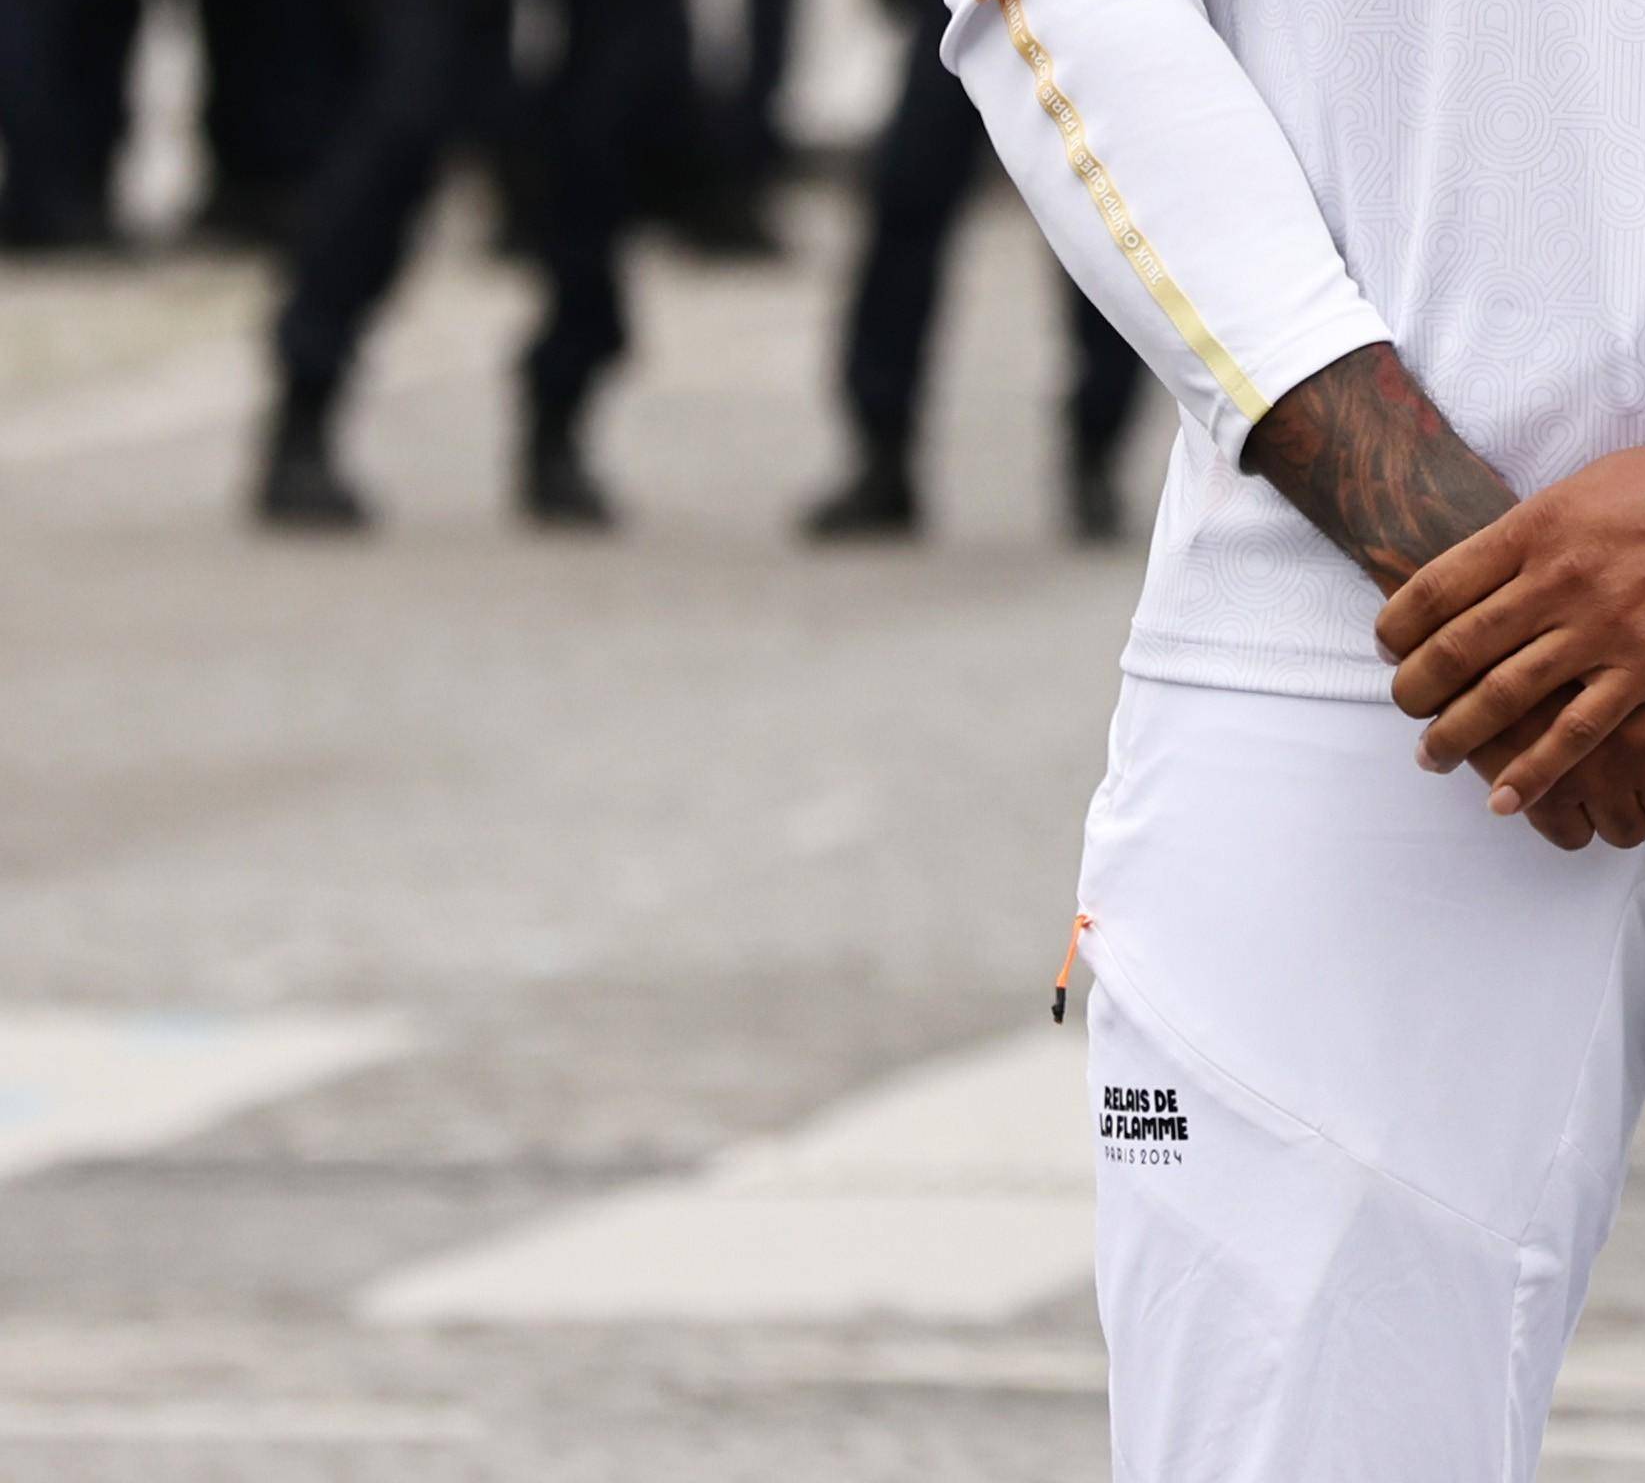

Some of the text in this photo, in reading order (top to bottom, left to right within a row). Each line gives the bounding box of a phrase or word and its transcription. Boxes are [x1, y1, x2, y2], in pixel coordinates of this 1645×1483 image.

[1041, 86, 1079, 134] PARIS
[1136, 247, 1164, 285] JEUX
[1104, 1086, 1179, 1114] RELAIS DE
[1099, 1113, 1190, 1141] LA FLAMME
[1140, 1148, 1183, 1166] 2024
